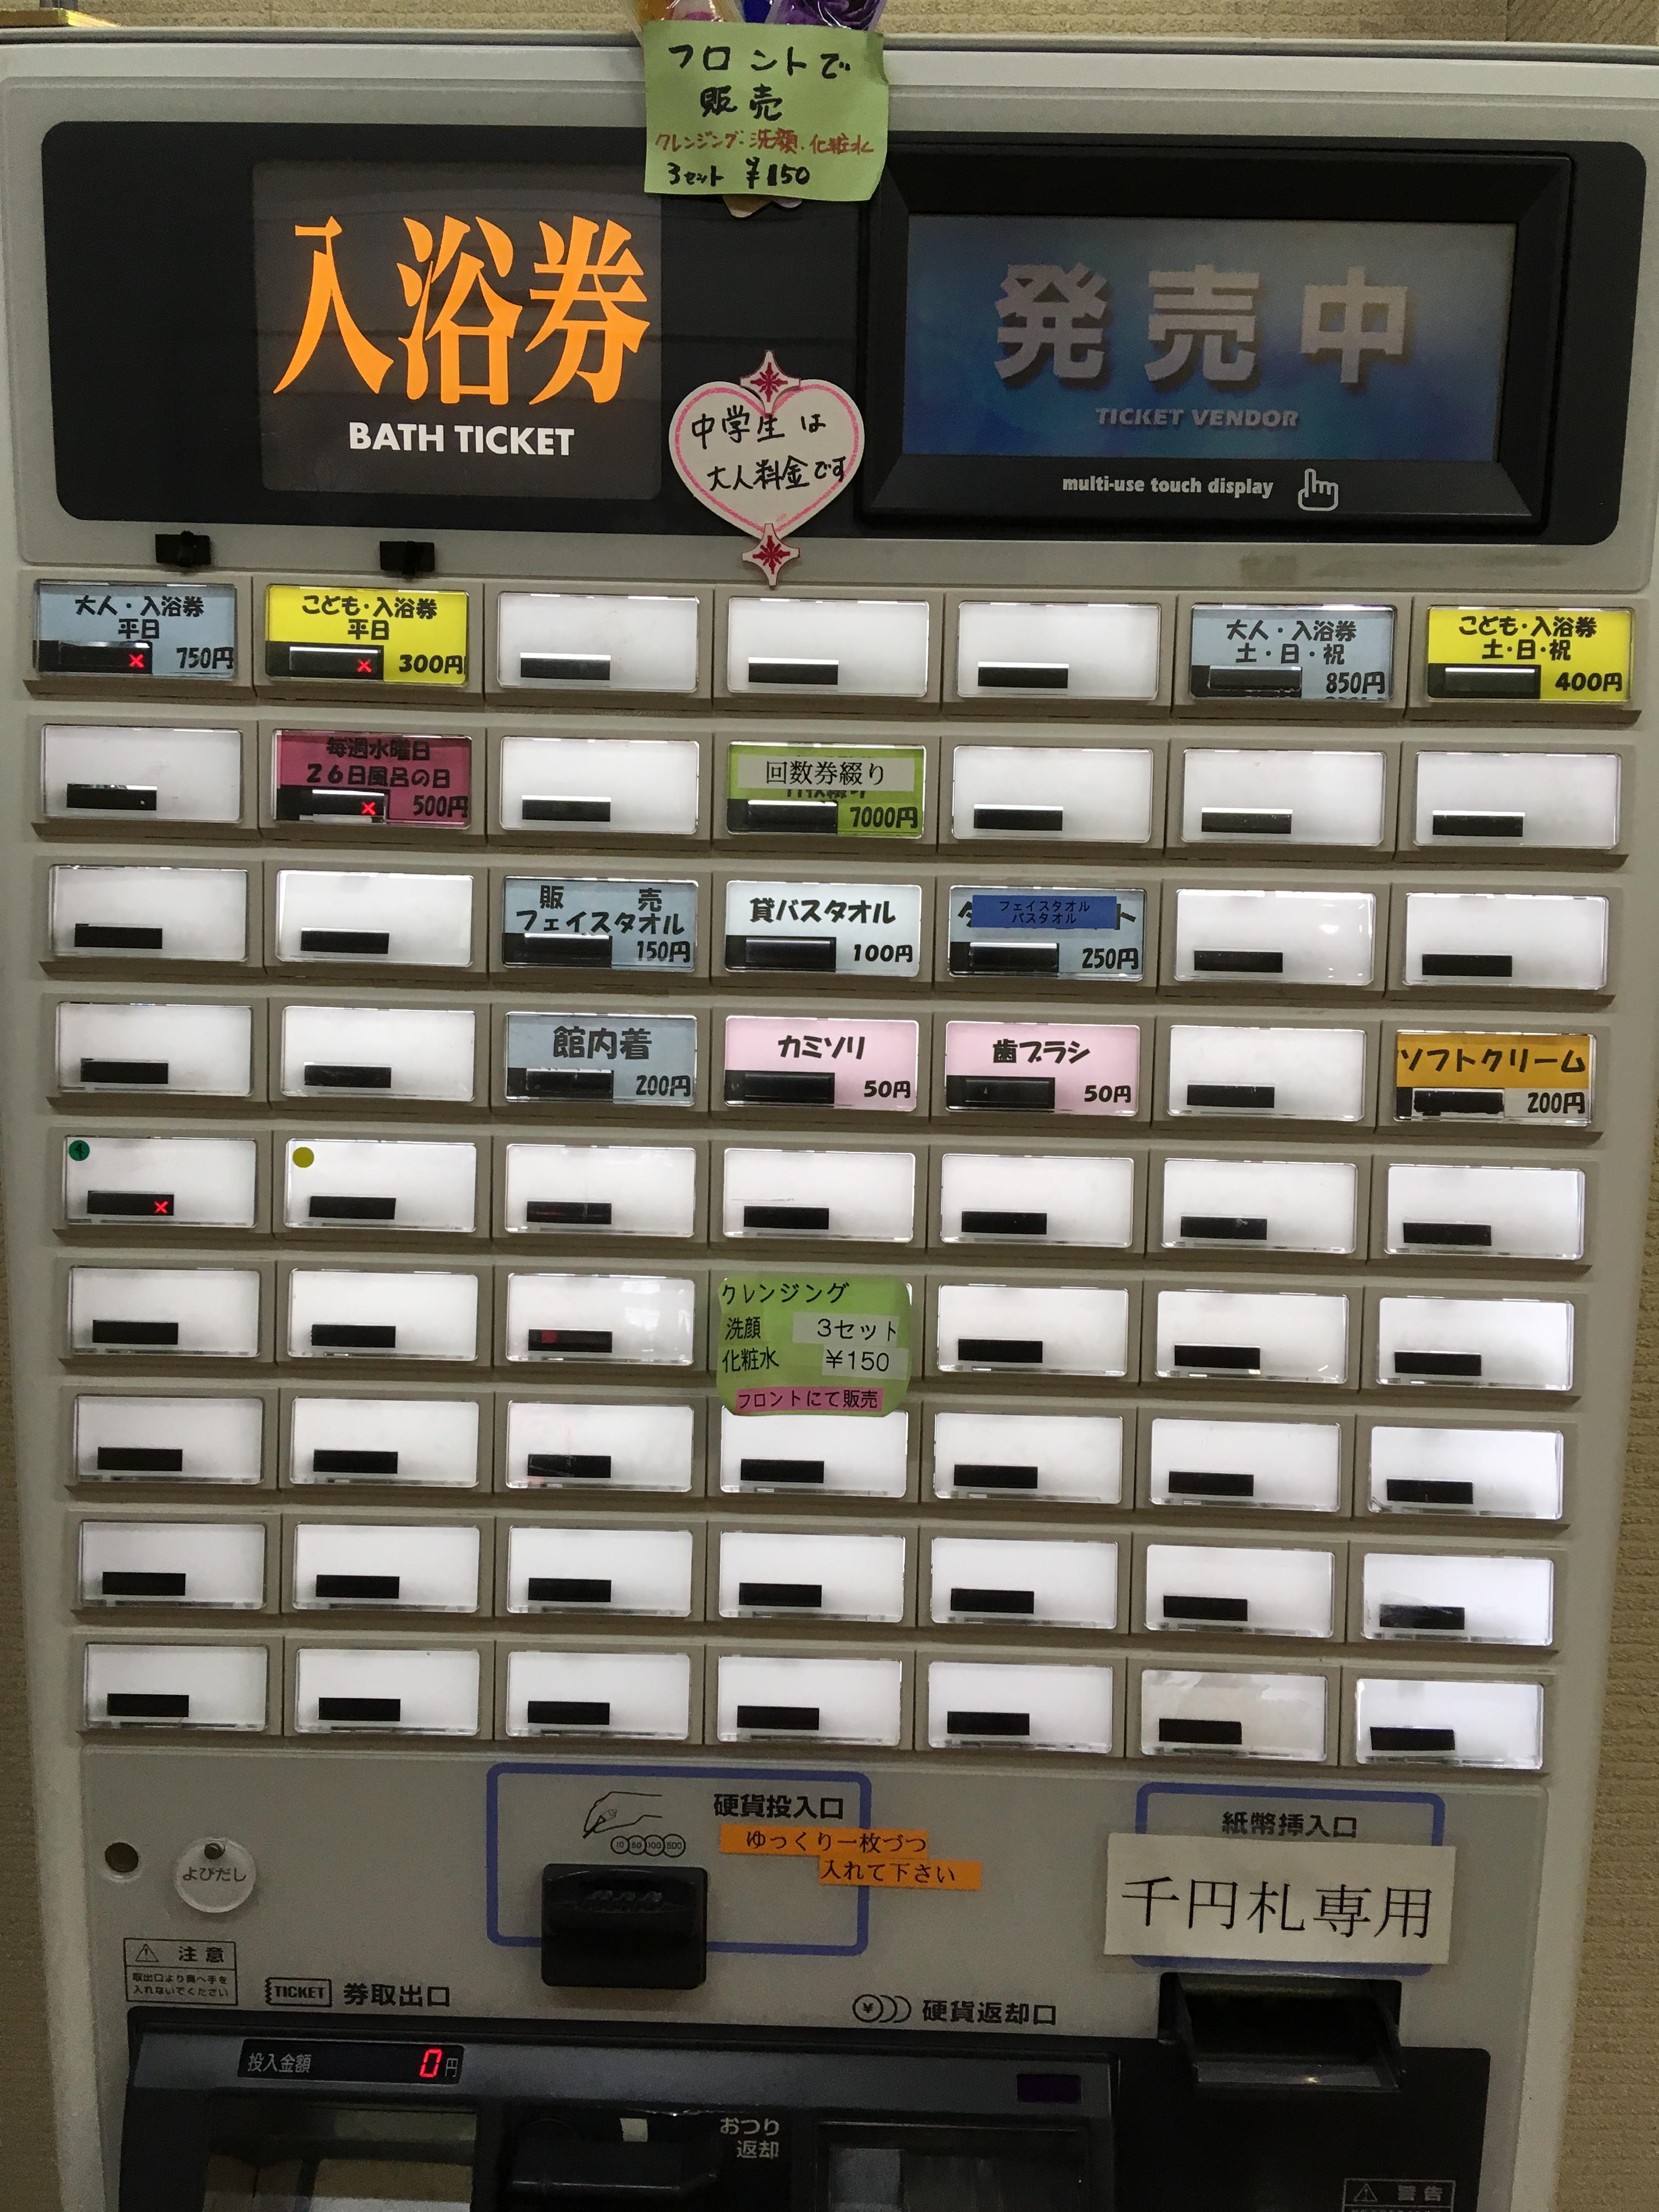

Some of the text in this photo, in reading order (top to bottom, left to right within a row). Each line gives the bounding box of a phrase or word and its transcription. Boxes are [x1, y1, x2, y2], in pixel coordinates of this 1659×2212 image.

[669, 44, 851, 79] フロントで
[701, 83, 782, 121] 販売
[668, 157, 810, 189] 3セット ¥150
[274, 216, 650, 405] 入浴券
[994, 262, 1408, 382] 発売中
[692, 405, 826, 449] 中学生は
[1096, 408, 1299, 427] TICKET VENDOR
[349, 422, 574, 455] BATH TICKET
[707, 455, 846, 491] 大人料金です
[1063, 476, 1273, 498] multi-use touch display
[75, 595, 204, 617] 大人・入浴券
[302, 595, 437, 619] こども・入浴券
[119, 619, 160, 639] 平日
[348, 619, 389, 640] 平日
[1227, 619, 1356, 642] 大人・入浴券
[1459, 616, 1597, 637] こども・入浴券
[177, 647, 233, 669] 750円
[399, 654, 463, 674] 300円
[1326, 672, 1385, 694] 850円
[1555, 673, 1622, 691] 400円
[327, 737, 430, 760] 毎週水曜日
[766, 761, 884, 785] 回数券綴り
[414, 795, 468, 817] 500円
[850, 806, 917, 828] 7000円
[749, 898, 896, 923] 貸バスタオル
[1000, 901, 1090, 912] フェイスタオル
[516, 910, 685, 935] フェイスタオル
[1012, 913, 1077, 924] バスタオル
[637, 940, 690, 962] 150円
[854, 944, 913, 962] 100円
[1082, 948, 1138, 969] 250円
[553, 1025, 652, 1060] 館内着
[778, 1035, 865, 1059] カミソリ
[993, 1039, 1091, 1064] 歯ブラシ
[1401, 1048, 1585, 1073] ソフトクリーム
[636, 1075, 691, 1097] 200円
[864, 1080, 911, 1098] 50円
[1084, 1085, 1131, 1103] 50円
[1528, 1092, 1585, 1114] 200円
[722, 1283, 850, 1305] クレンジング
[725, 1317, 761, 1340] 洗顔
[817, 1318, 896, 1341] 3セット
[722, 1347, 779, 1373] 化粧水
[826, 1350, 889, 1372] ¥150
[738, 1389, 878, 1408] フロントにて販売
[714, 1793, 844, 1819] 硬貨投入口
[1222, 1812, 1357, 1838] 紙幣挿入口
[746, 1830, 927, 1853] ゆっくり一枚づつ
[182, 1866, 247, 1882] よびだし
[821, 1859, 955, 1883] 入れて下さい
[1122, 1876, 1432, 1939] 千円札専用
[178, 1946, 224, 1963] 注意
[133, 1985, 229, 1997] 入れないでください
[274, 1986, 325, 1999] TICKET
[343, 1983, 450, 2007] 券取出口
[923, 2000, 1057, 2025] 硬貨返却口
[247, 2052, 312, 2074] 投入金額
[720, 2118, 780, 2136] おつり
[736, 2140, 780, 2159] 返却
